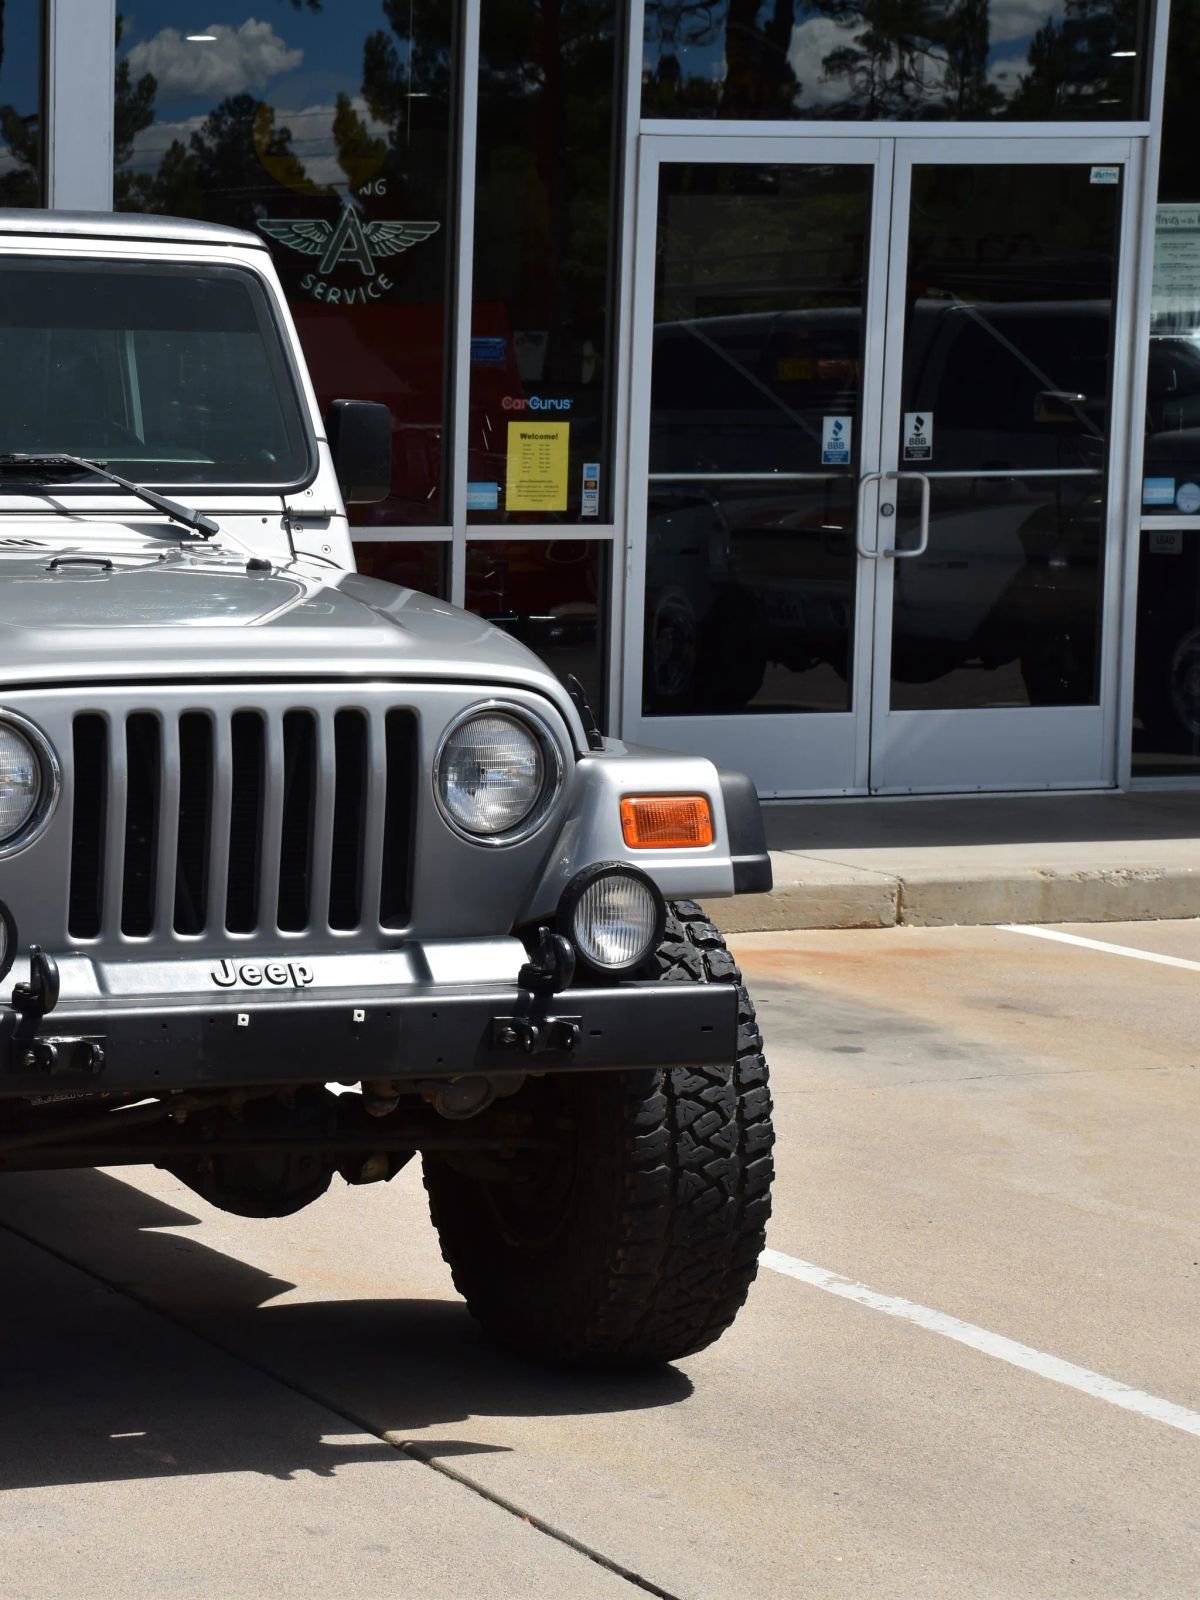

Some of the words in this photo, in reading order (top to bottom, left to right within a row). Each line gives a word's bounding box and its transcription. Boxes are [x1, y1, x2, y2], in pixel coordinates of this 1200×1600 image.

[300, 272, 395, 304] SERVICE
[501, 395, 571, 410] CarGurus
[519, 432, 559, 441] Welcome!
[909, 437, 927, 445] BBB
[210, 958, 314, 988] Jeep
